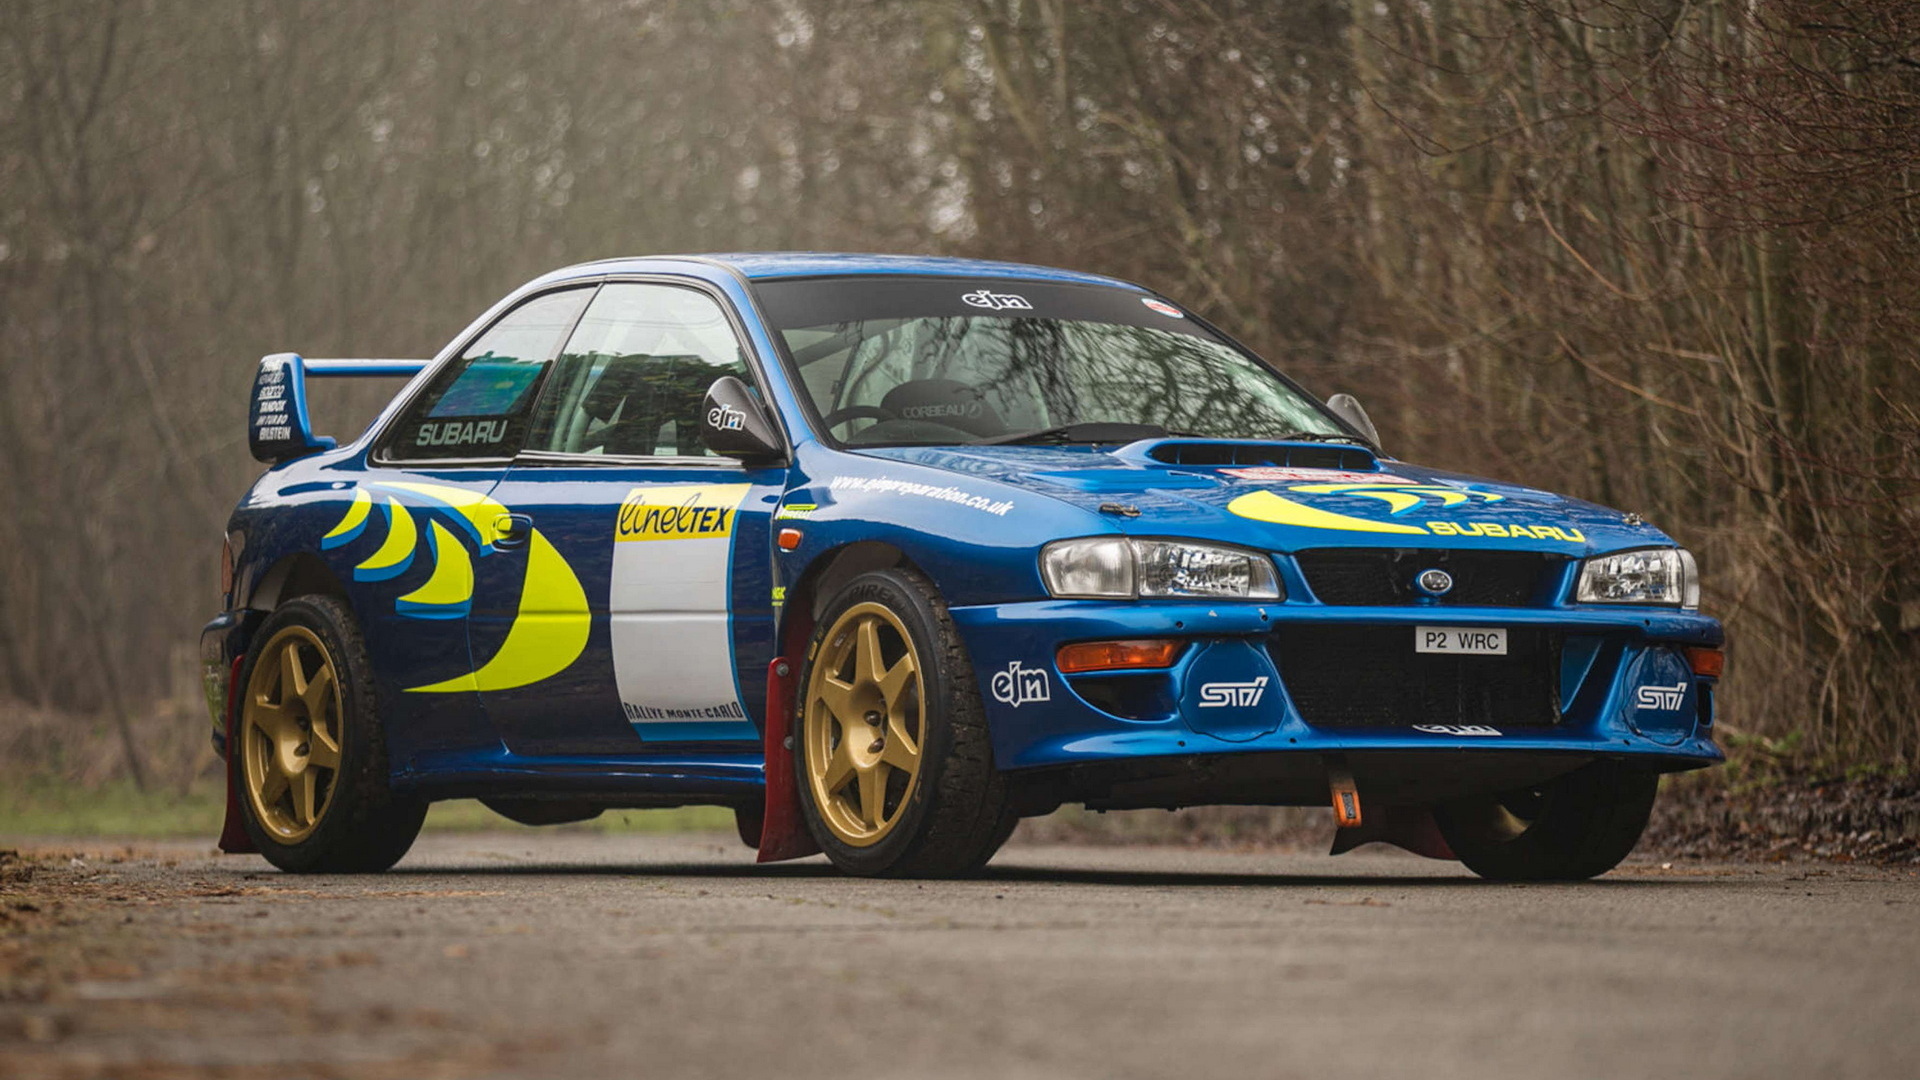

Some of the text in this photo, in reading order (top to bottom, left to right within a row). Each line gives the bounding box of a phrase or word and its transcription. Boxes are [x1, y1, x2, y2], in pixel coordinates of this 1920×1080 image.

[903, 404, 965, 419] CORBEAU
[259, 427, 291, 440] BILSTEIN
[416, 420, 508, 446] SUBARU
[1426, 521, 1586, 543] SUBARU
[1426, 632, 1499, 649] P2 WRC
[623, 702, 664, 719] RALLYE
